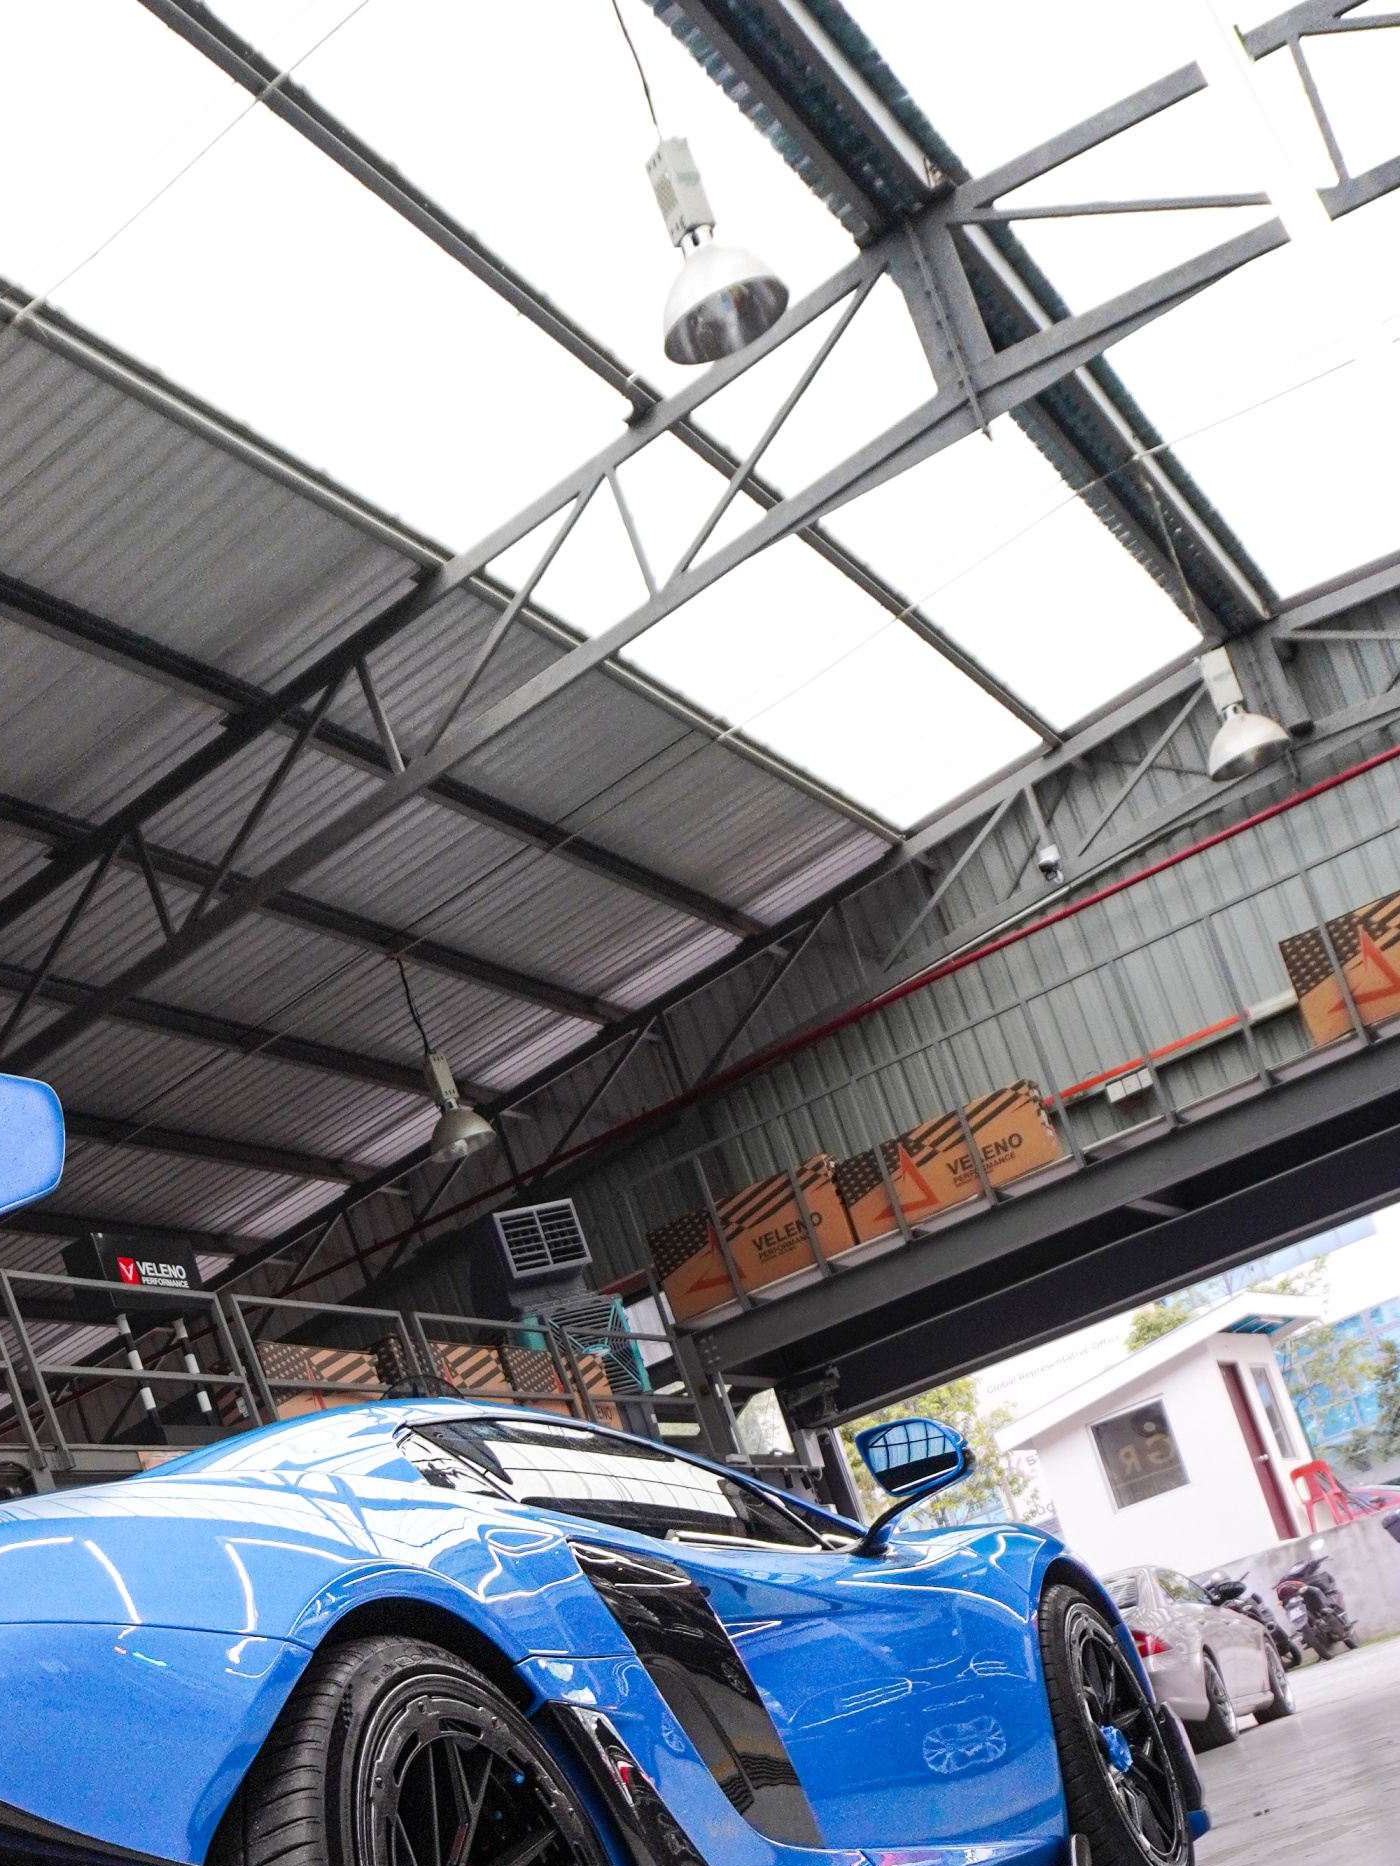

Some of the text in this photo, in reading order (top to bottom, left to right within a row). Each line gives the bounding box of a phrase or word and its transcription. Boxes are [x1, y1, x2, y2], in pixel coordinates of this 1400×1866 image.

[946, 1132, 1023, 1175] VEENO
[953, 1152, 1016, 1182] PERFMANCE
[136, 1261, 187, 1279] VELENO
[141, 1277, 190, 1288] PERFORMANCE
[986, 1376, 1016, 1394] Global
[1018, 1346, 1089, 1382] Representative
[1092, 1334, 1122, 1351] Office
